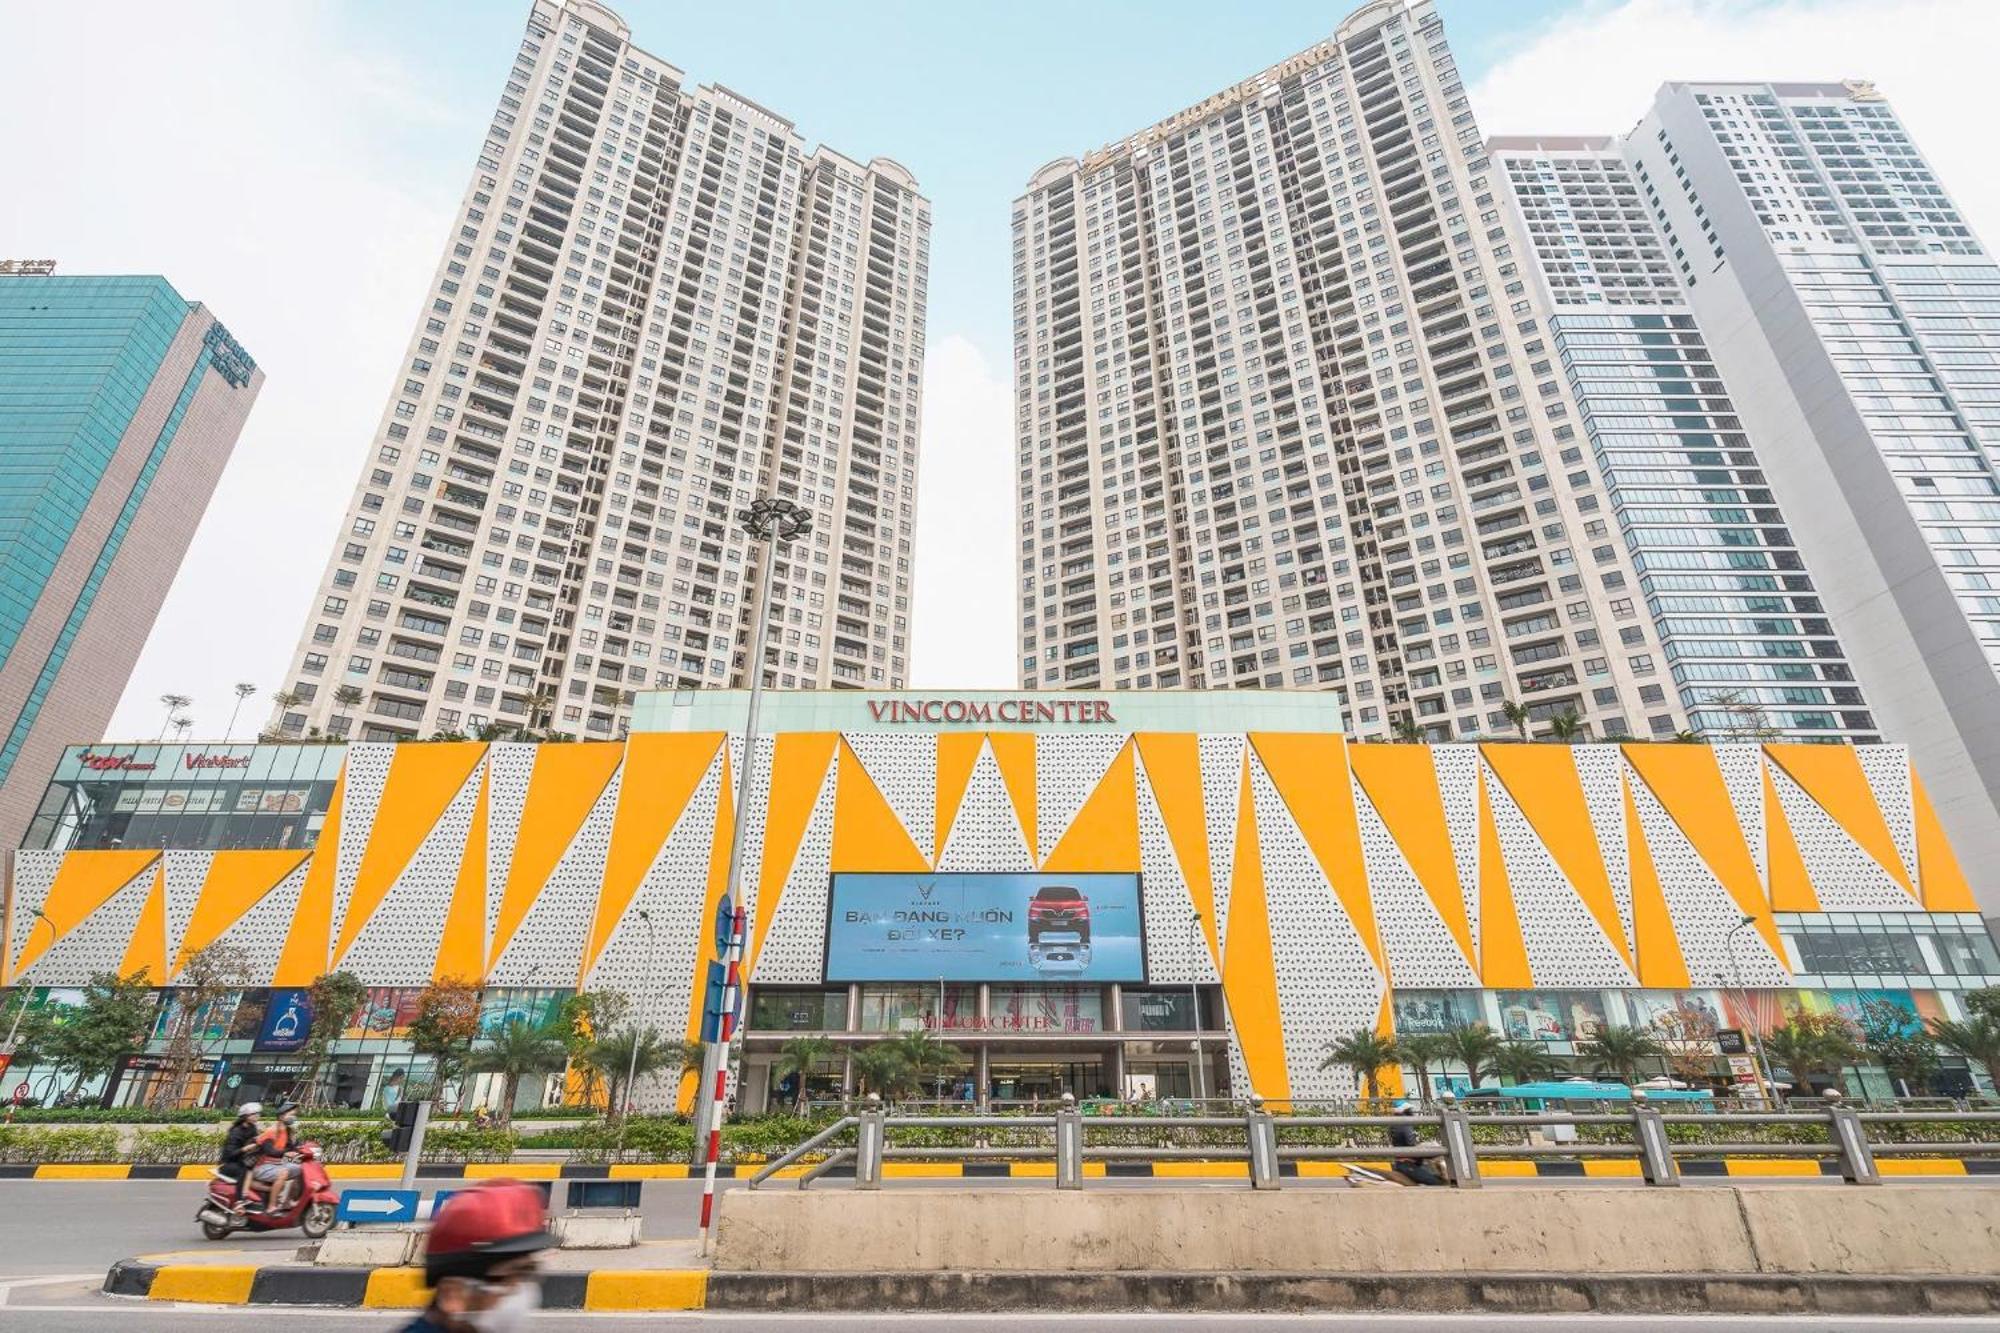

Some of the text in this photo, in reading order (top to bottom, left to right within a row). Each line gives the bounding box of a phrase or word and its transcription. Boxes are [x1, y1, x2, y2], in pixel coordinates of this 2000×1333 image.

[203, 330, 249, 388] PLAZA
[867, 700, 1117, 724] VINCOM CENTER
